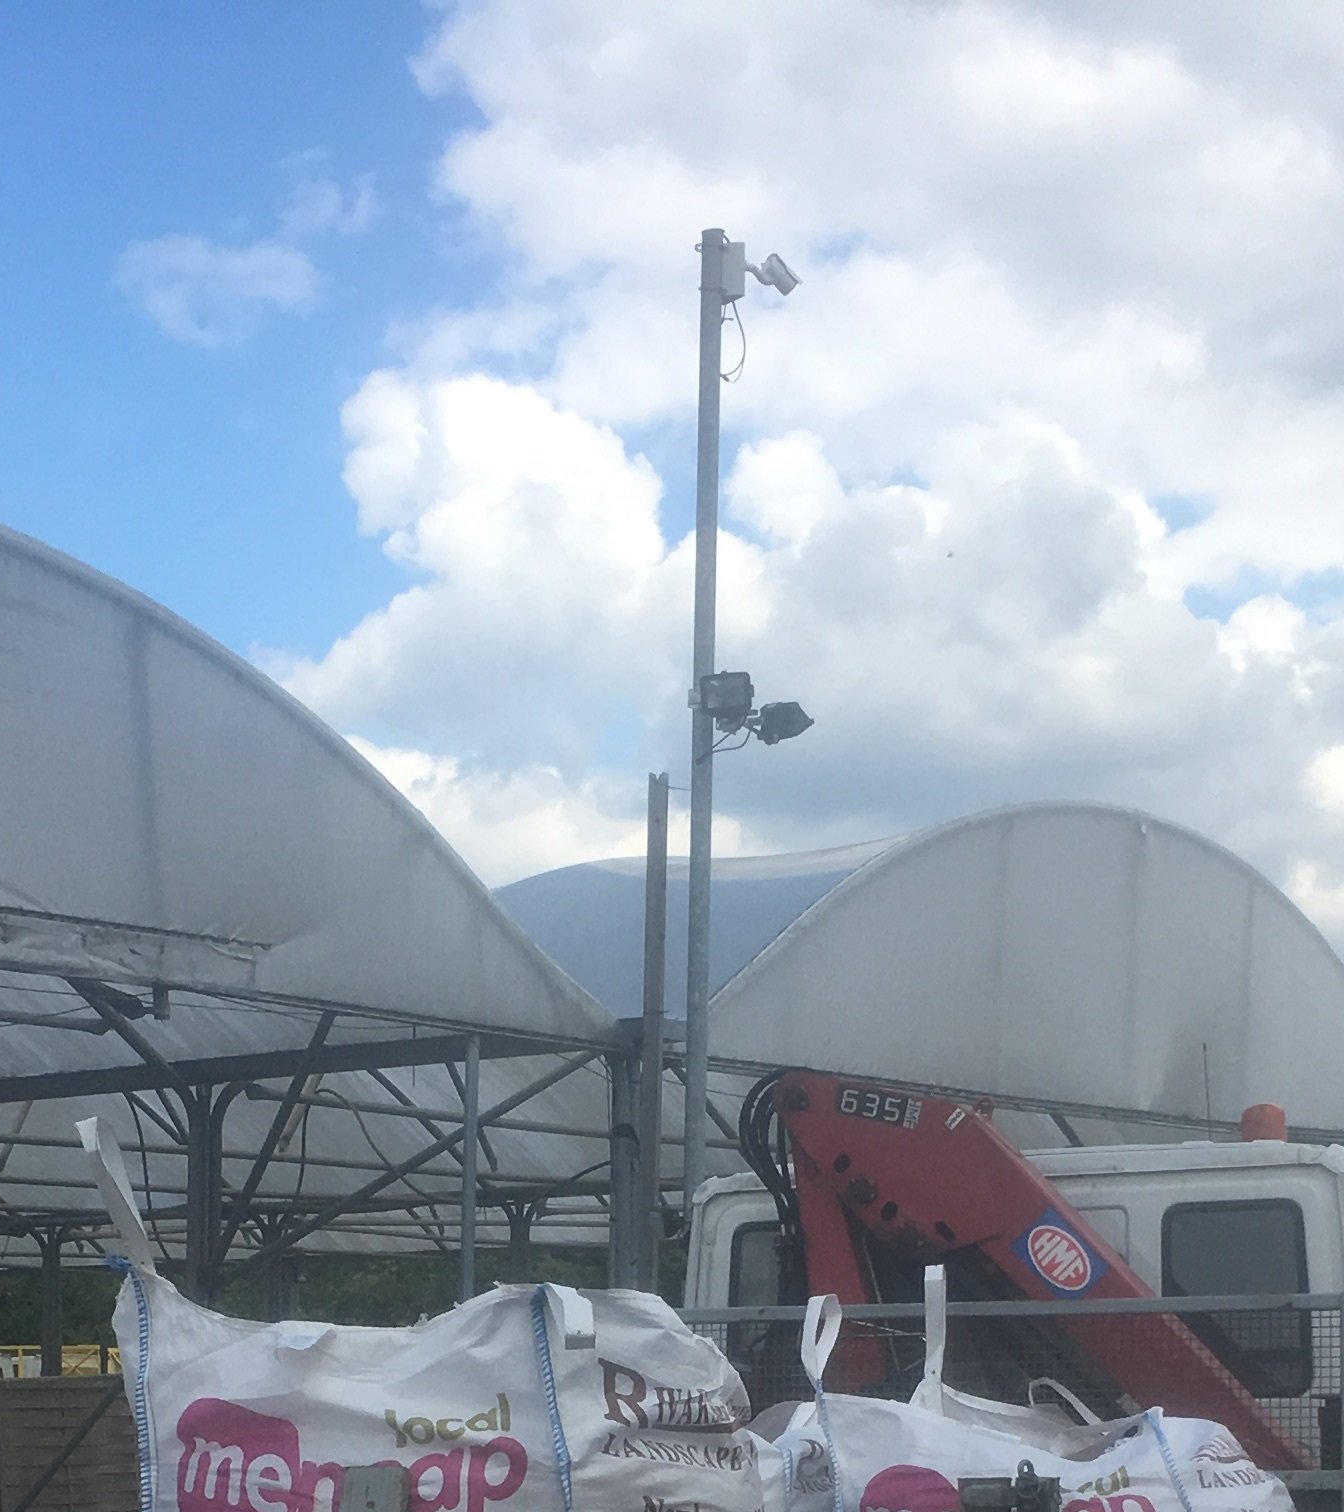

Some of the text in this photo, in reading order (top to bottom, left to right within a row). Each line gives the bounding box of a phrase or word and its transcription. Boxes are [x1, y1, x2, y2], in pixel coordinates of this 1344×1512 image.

[840, 1089, 902, 1122] 635
[1034, 1232, 1084, 1281] HMF
[384, 1393, 511, 1448] local
